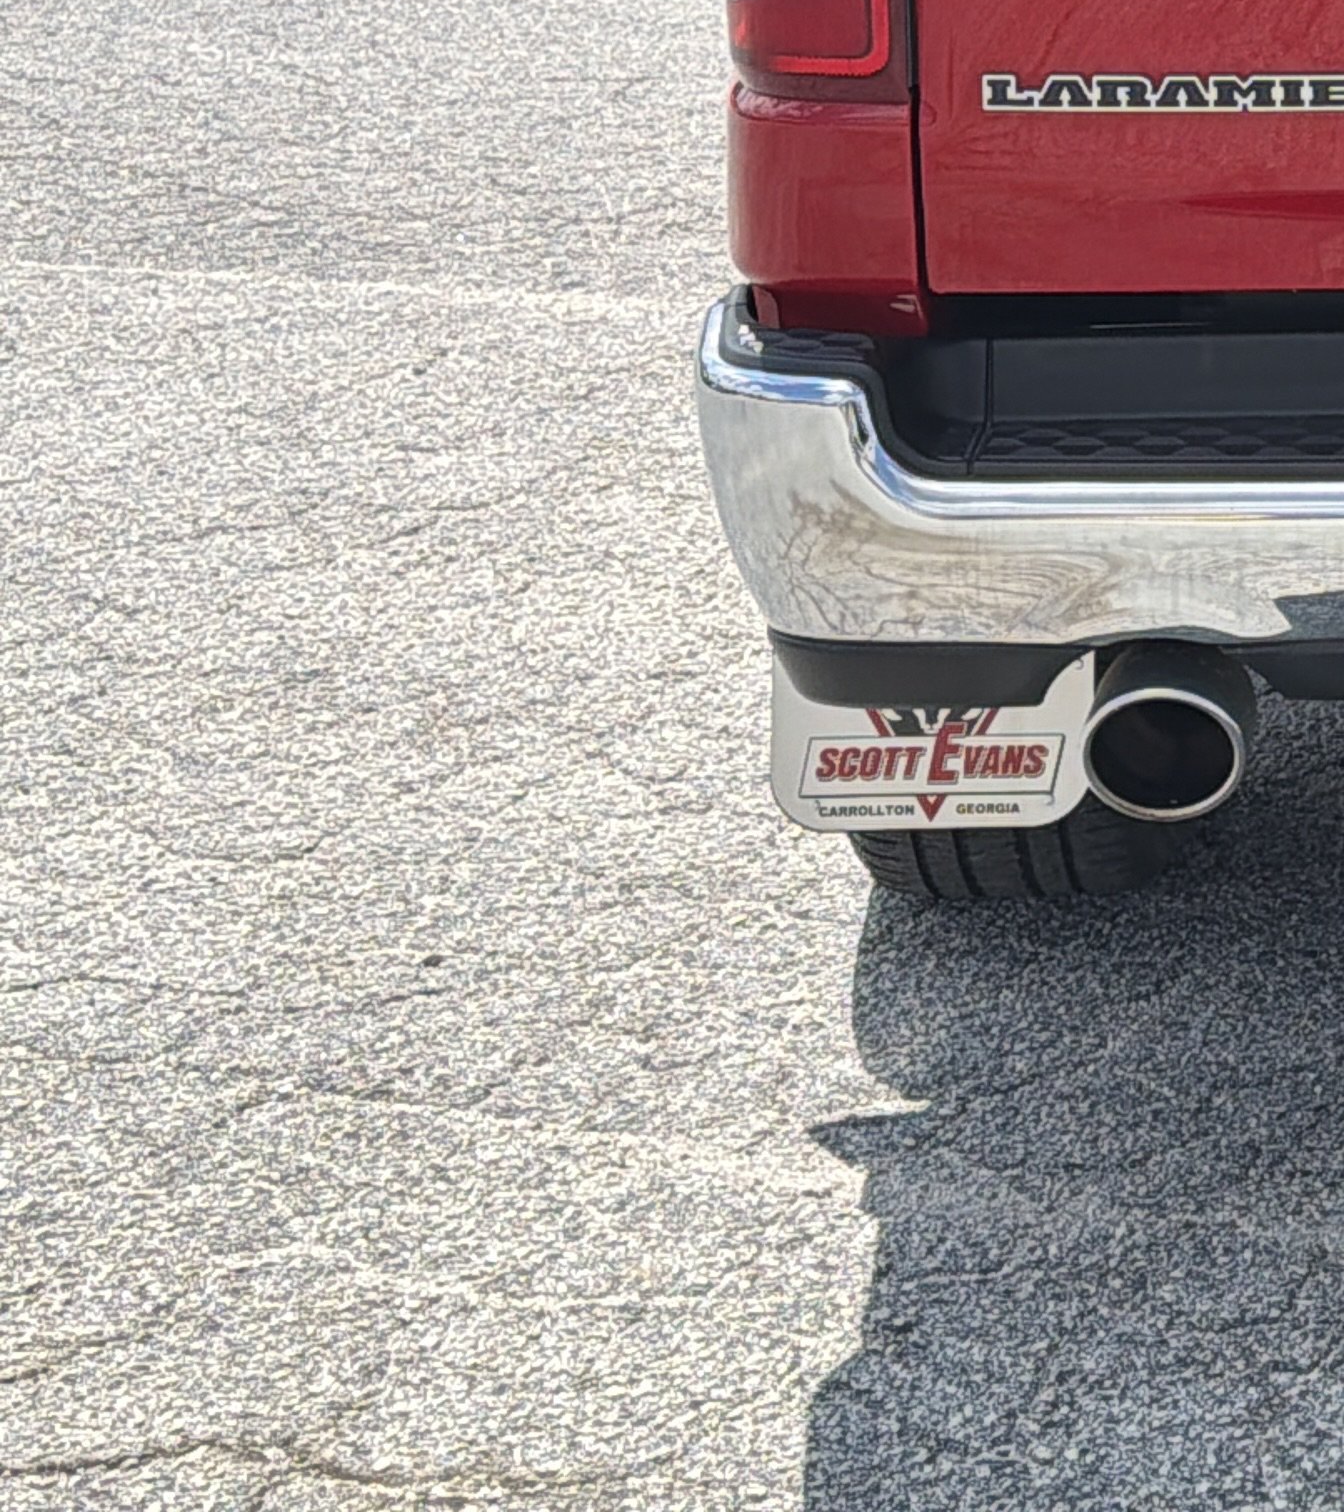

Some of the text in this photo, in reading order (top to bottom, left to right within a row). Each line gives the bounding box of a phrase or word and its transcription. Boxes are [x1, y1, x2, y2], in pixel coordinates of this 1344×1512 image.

[815, 721, 1050, 786] SCOTT EVANS
[819, 802, 1020, 817] CARROLLTON GEORGIA
